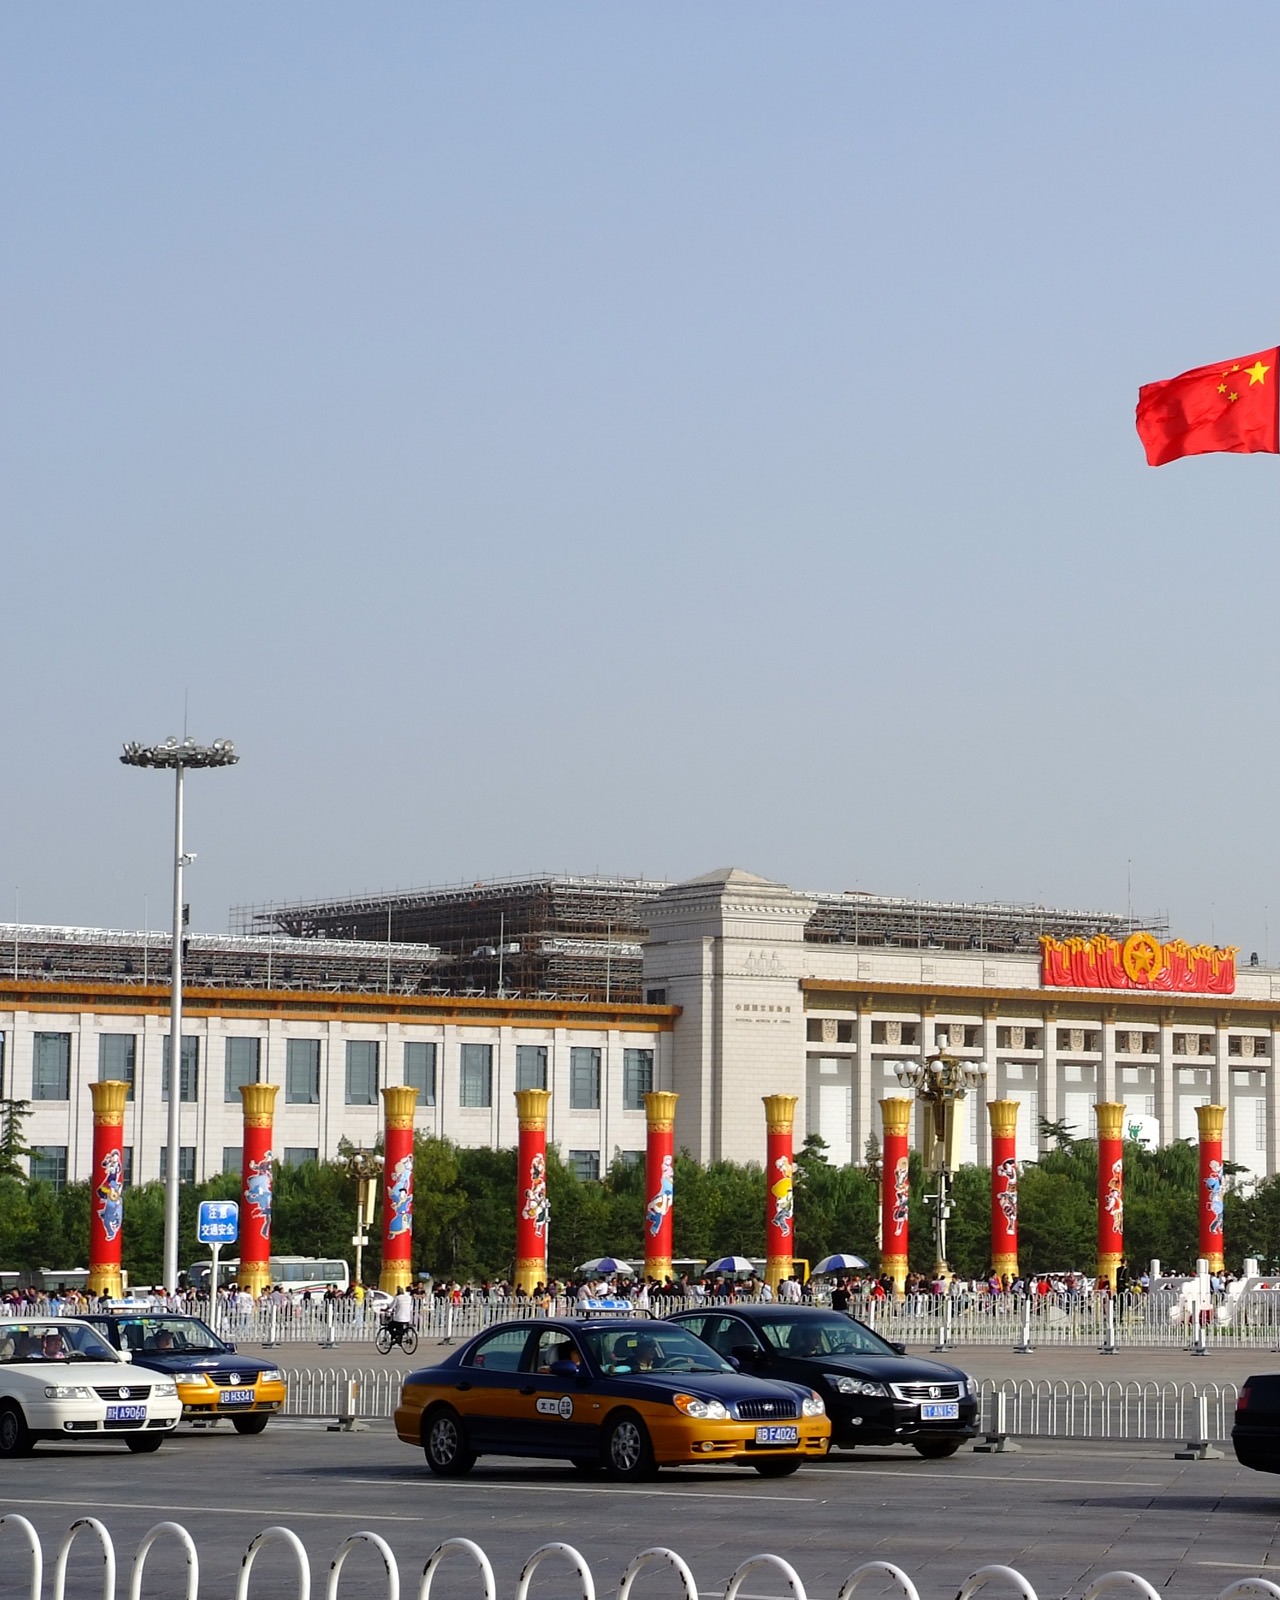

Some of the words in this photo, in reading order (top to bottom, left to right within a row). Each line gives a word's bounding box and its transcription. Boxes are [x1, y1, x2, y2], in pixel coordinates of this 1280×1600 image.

[209, 1204, 228, 1219] 注意
[201, 1223, 235, 1236] 交通安全
[769, 1428, 797, 1440] F4026
